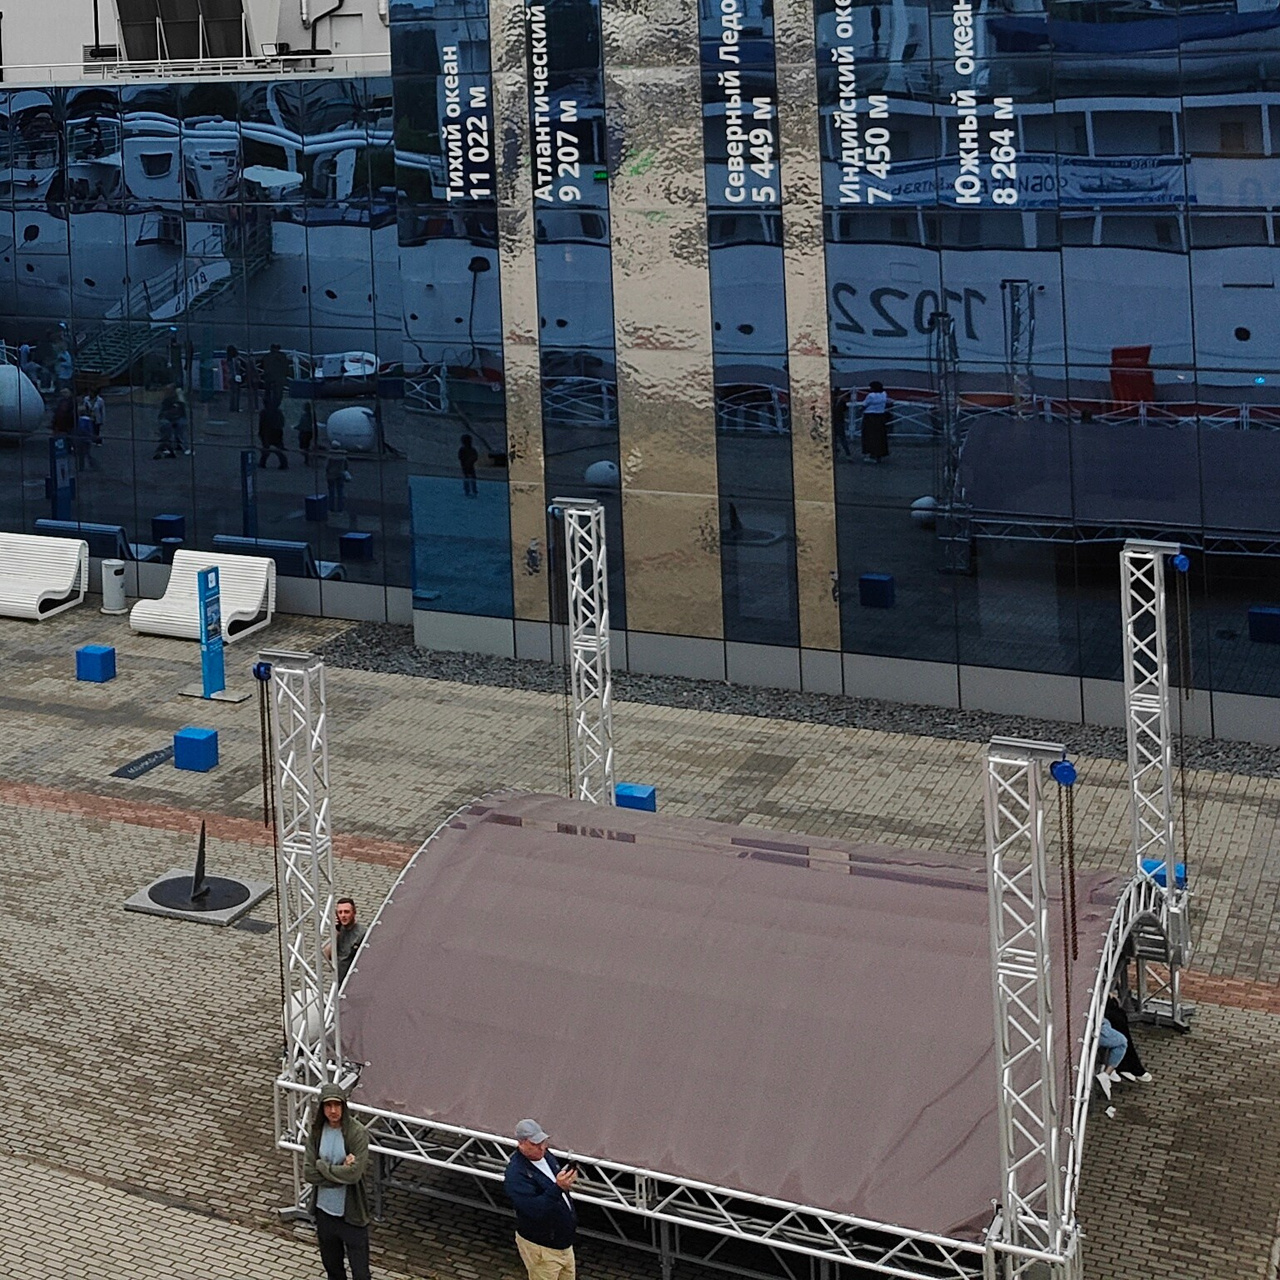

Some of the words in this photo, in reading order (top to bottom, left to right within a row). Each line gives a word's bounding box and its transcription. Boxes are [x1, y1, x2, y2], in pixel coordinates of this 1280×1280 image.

[442, 46, 461, 118] океан
[468, 86, 488, 109] м
[525, 5, 551, 202] Атлантический
[559, 100, 578, 123] м
[752, 96, 773, 121] м
[831, 46, 864, 204] Индийский
[868, 95, 890, 119] м
[993, 96, 1014, 120] м
[466, 115, 490, 163] 022
[556, 129, 581, 179] 207
[718, 69, 748, 203] Северный
[748, 127, 775, 179] 449
[864, 126, 892, 180] 450
[950, 90, 981, 204] Южный
[990, 127, 1017, 180] 264
[441, 124, 464, 202] Тихий
[469, 171, 492, 201] 11
[557, 184, 582, 203] 9
[751, 185, 776, 203] 5
[867, 186, 893, 205] 7
[992, 187, 1019, 206] 8
